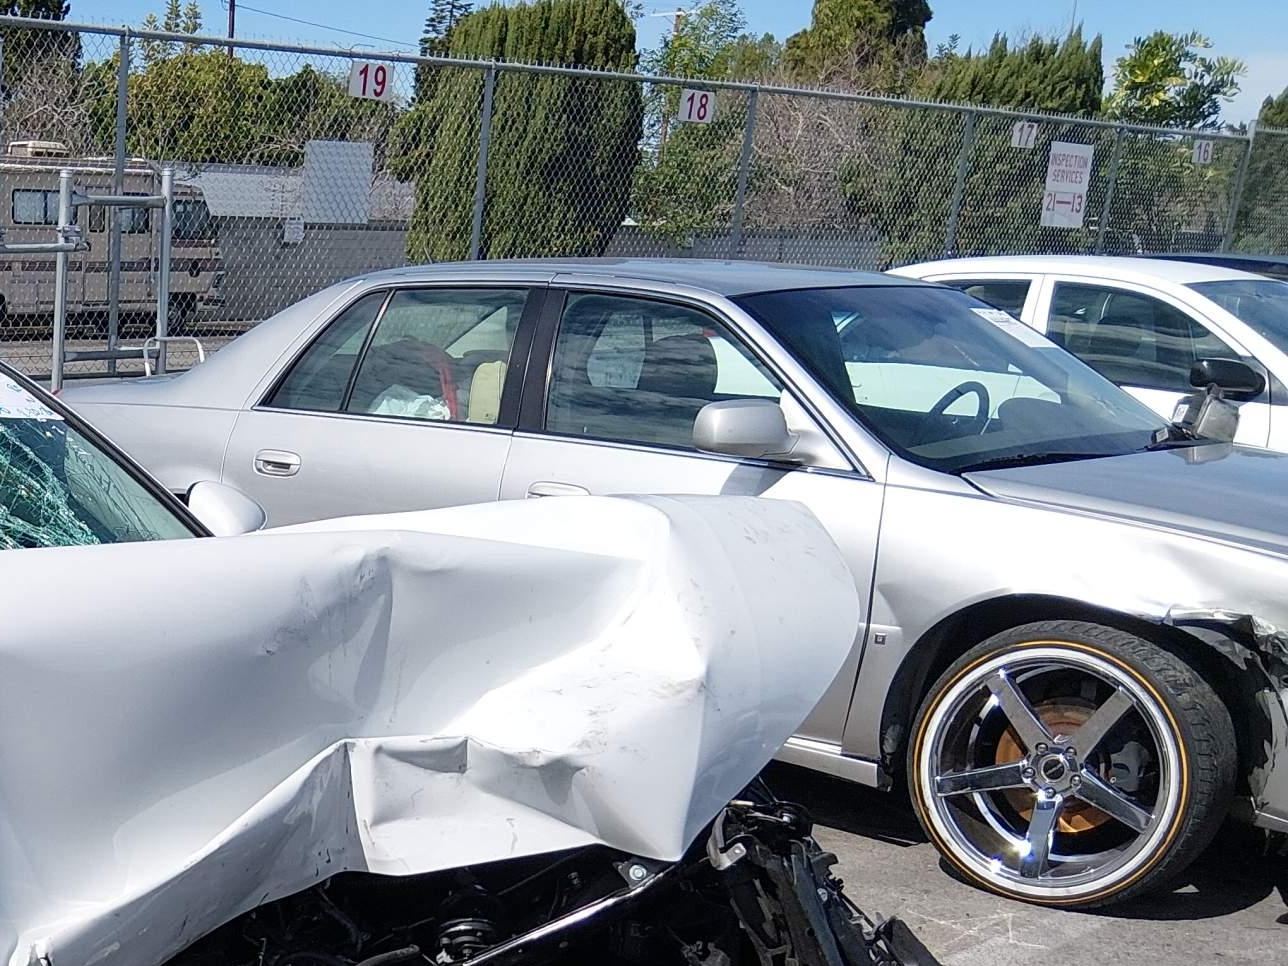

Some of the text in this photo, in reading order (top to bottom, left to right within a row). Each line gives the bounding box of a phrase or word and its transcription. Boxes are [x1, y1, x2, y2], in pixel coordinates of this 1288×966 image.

[359, 63, 387, 97] 19
[686, 92, 709, 120] 18
[1018, 123, 1035, 146] 17
[1050, 152, 1088, 168] INSPECTION
[1196, 141, 1211, 162] 16
[1052, 168, 1084, 184] SERVICES
